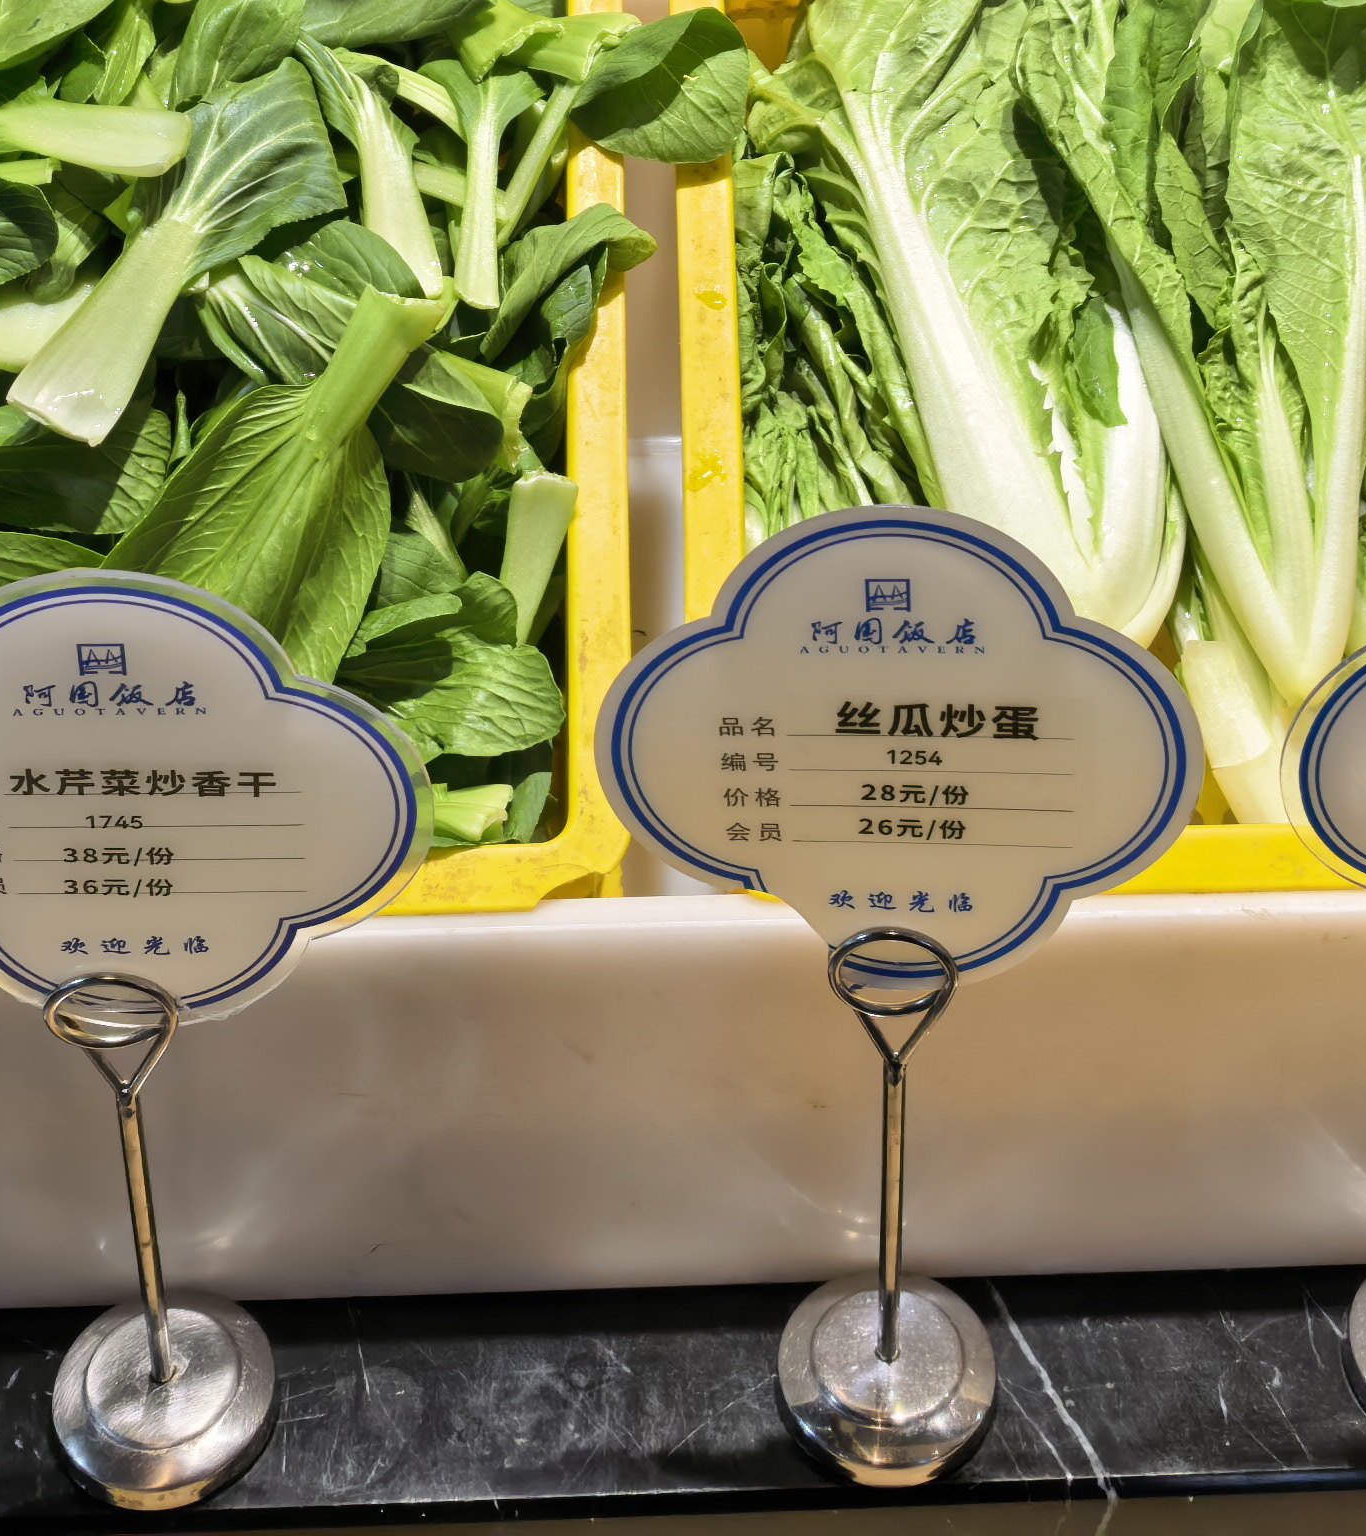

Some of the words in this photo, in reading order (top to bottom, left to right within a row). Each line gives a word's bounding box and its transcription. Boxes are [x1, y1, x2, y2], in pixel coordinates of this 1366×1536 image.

[718, 716, 778, 737] 品名
[835, 701, 1040, 741] 丝瓜炒蛋
[720, 751, 780, 772] 编号
[885, 749, 943, 766] 1254
[9, 769, 277, 798] 水芹菜炒香干
[723, 786, 782, 808] 价格
[860, 783, 969, 806] 28元/份
[85, 815, 144, 830] 1745
[726, 821, 783, 842] 会员
[858, 817, 967, 841] 26元/份
[62, 846, 175, 867] 38元/份
[63, 877, 174, 899] 36元/份
[829, 889, 974, 914] 欢迎光临
[60, 935, 210, 956] 欢迎光临
